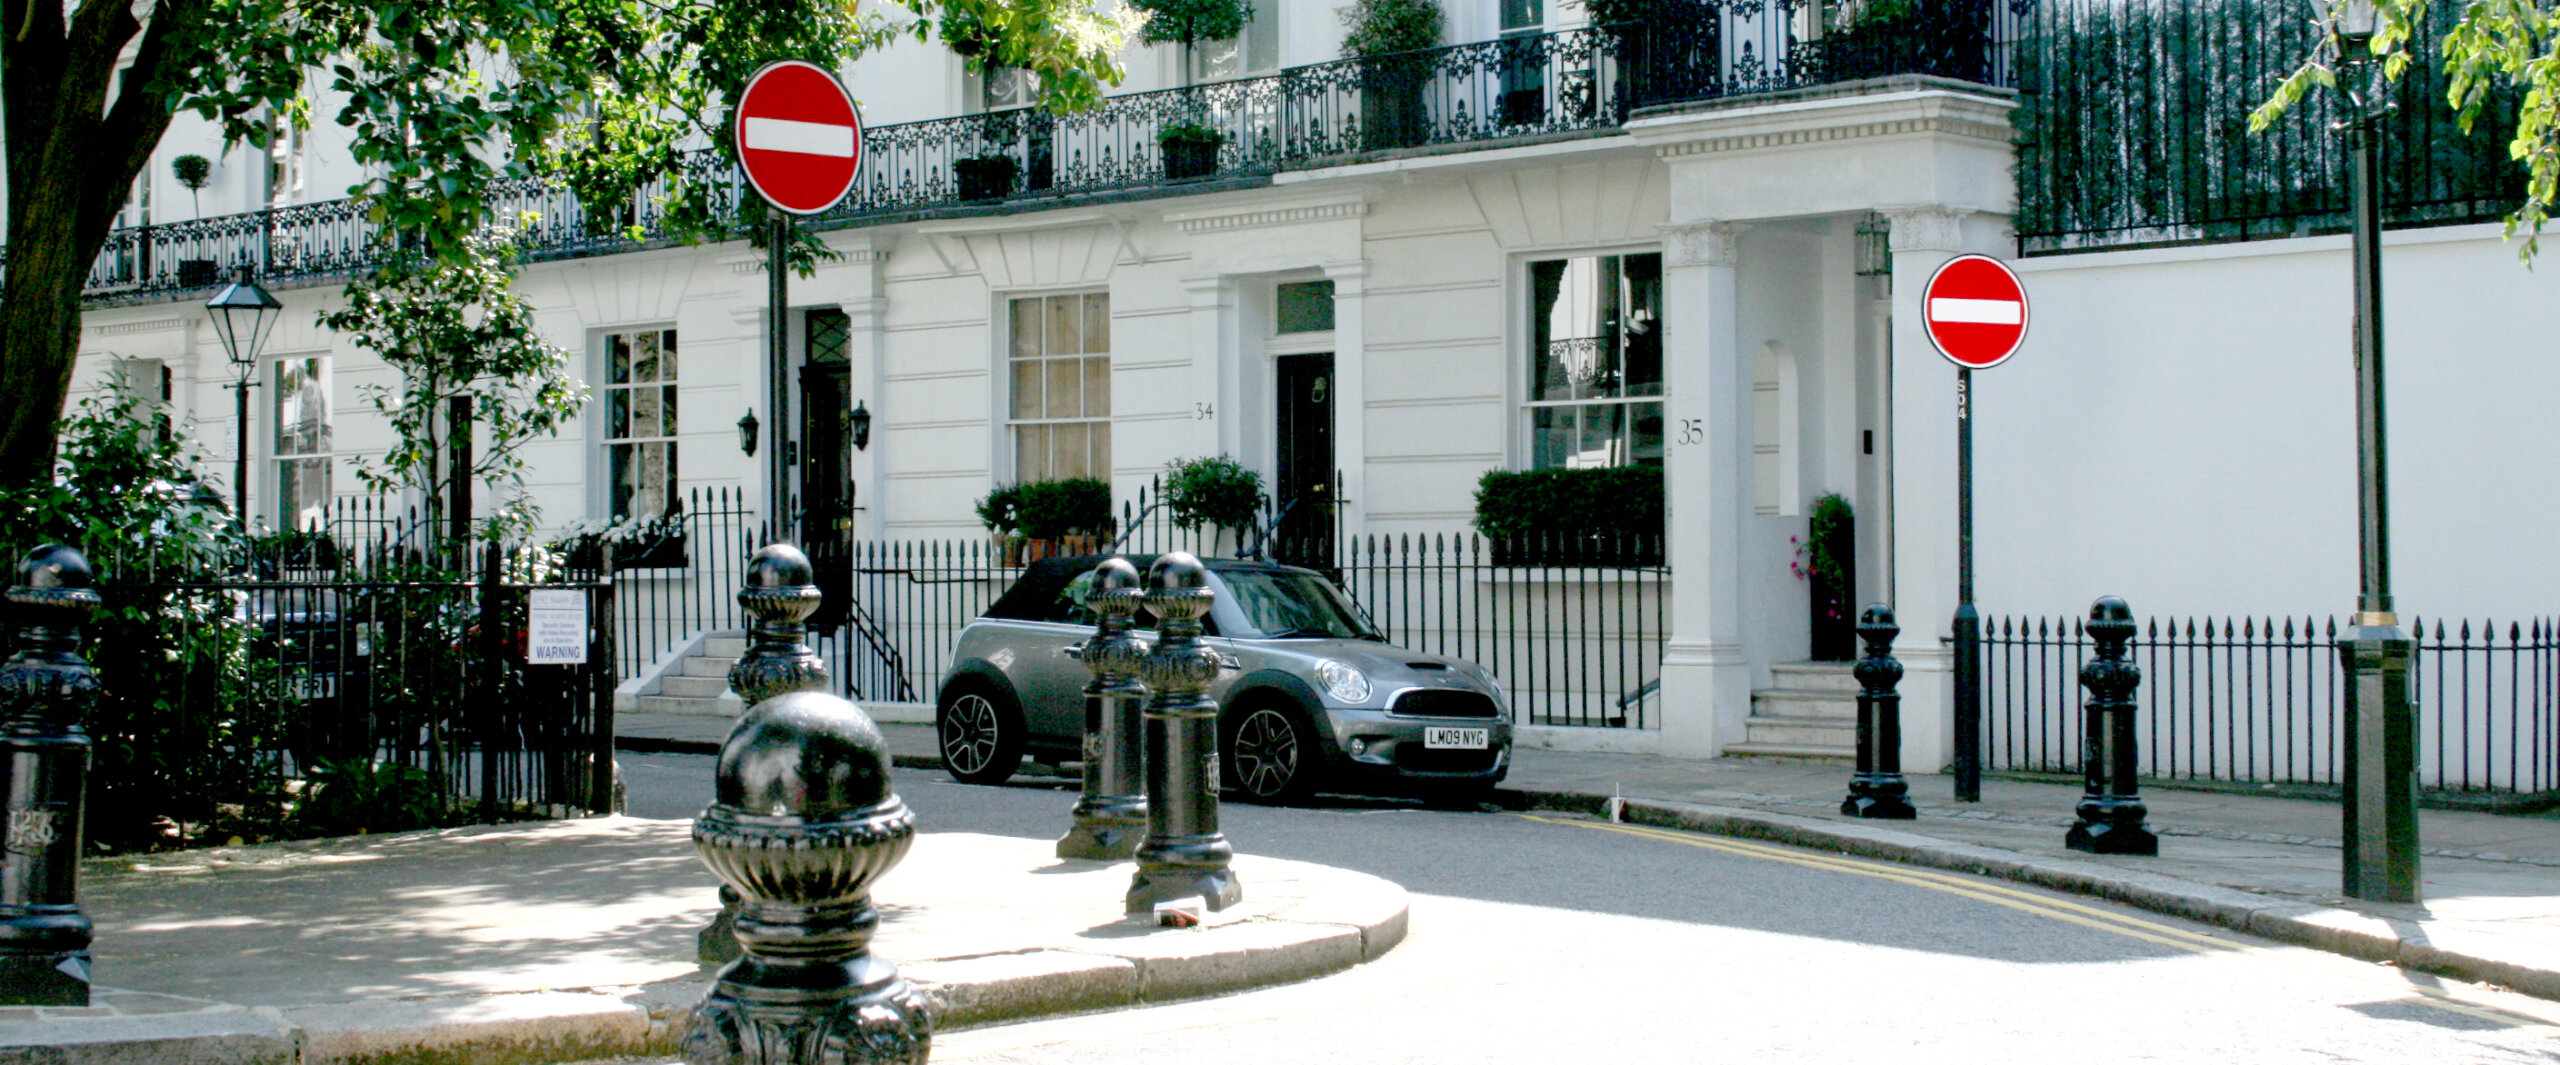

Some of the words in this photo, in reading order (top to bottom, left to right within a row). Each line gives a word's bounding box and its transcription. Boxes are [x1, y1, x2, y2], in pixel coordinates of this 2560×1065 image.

[1195, 401, 1214, 420] 34
[1678, 419, 1703, 445] 35
[536, 646, 581, 659] WARNING
[1429, 730, 1460, 745] LM09
[1462, 730, 1483, 745] NYG
